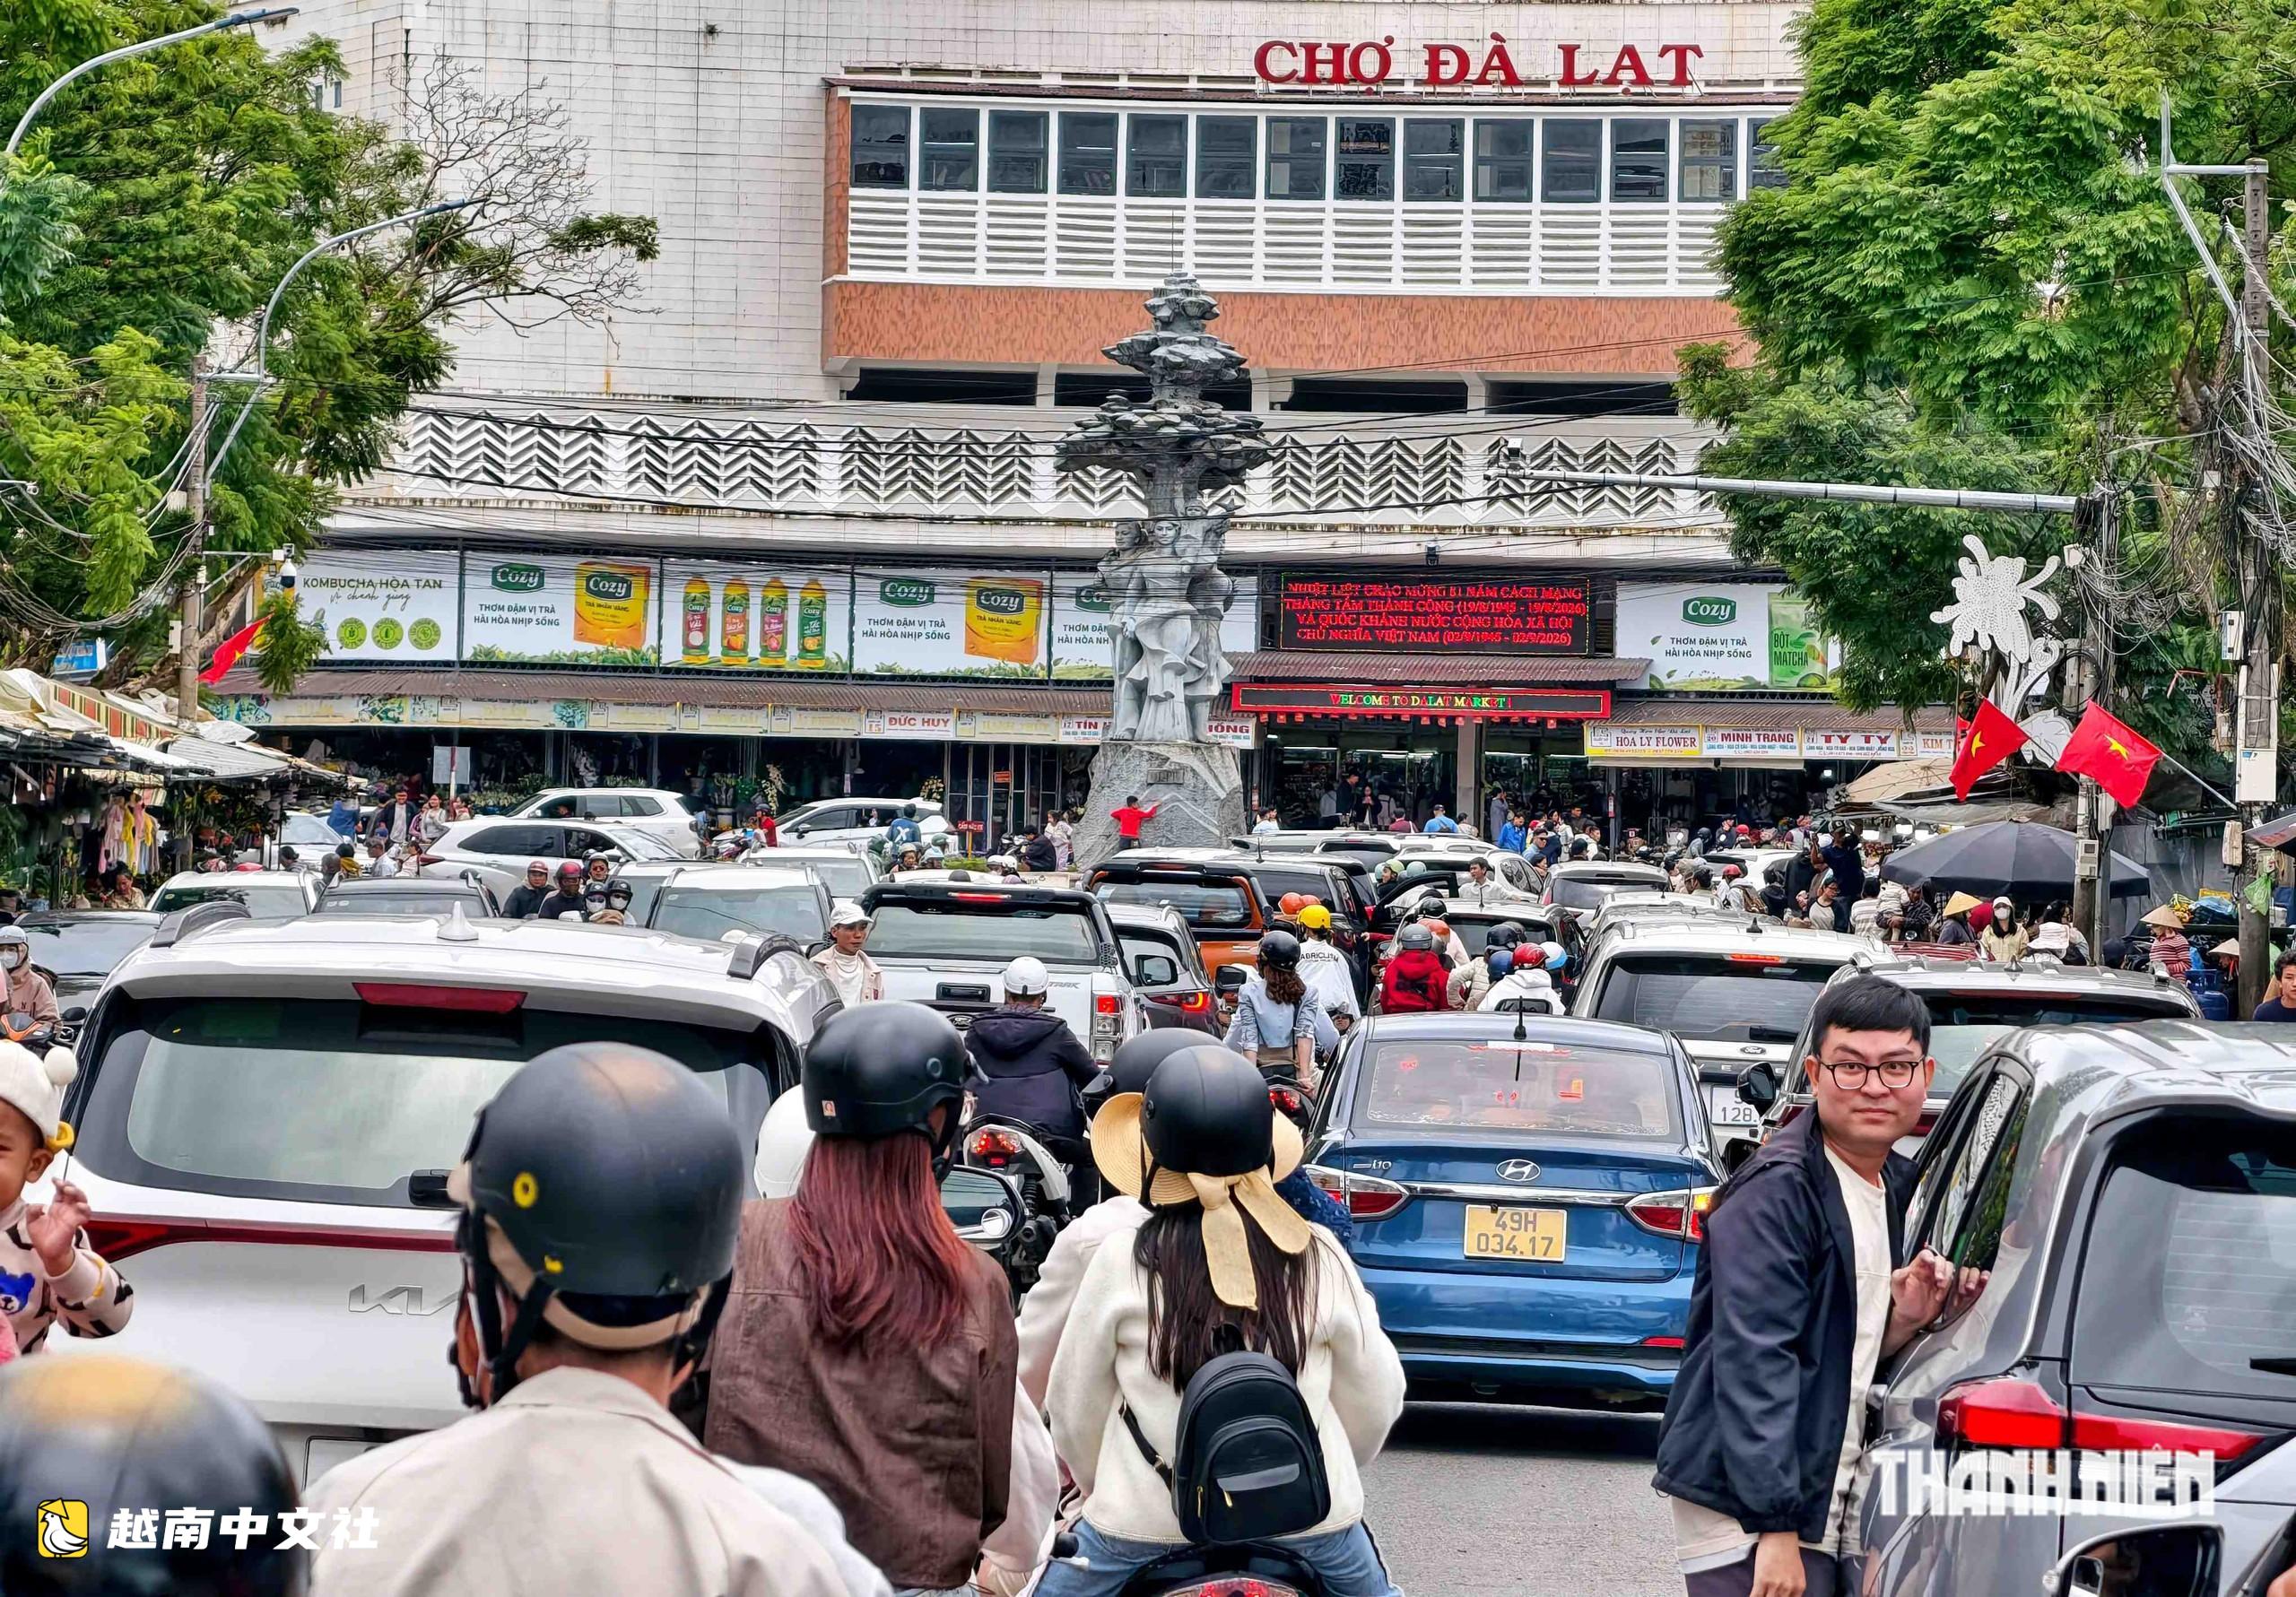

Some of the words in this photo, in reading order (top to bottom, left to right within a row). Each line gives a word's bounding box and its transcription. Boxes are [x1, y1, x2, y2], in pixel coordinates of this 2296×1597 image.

[1255, 35, 1395, 96] CHỢ
[1423, 31, 1523, 87] ĐÀ
[1557, 43, 1704, 96] LẠT
[303, 577, 378, 589] KOMBUCHA
[379, 577, 410, 589] HÒA
[414, 579, 442, 589] TAN
[496, 568, 539, 587] Cozy
[589, 577, 627, 597] Cozy
[884, 583, 929, 601] Cozy
[980, 592, 1020, 611] Cozy
[1080, 589, 1102, 603] Co
[479, 603, 505, 612] THƠM
[507, 603, 526, 615] ĐẬM
[528, 605, 536, 616] VỊ
[539, 603, 555, 613] TRÀ
[1687, 600, 1731, 621] Cozy
[474, 615, 489, 624] HÀI
[491, 615, 509, 625] HÒA
[511, 616, 533, 627] NHỊP
[535, 615, 560, 626] SỐNG
[867, 618, 894, 627] THƠM
[896, 617, 916, 629] ĐẬM
[918, 620, 926, 629] VỊ
[929, 618, 945, 629] TRÀ
[1063, 623, 1089, 632] THƠM
[862, 629, 877, 638] HÀI
[879, 629, 899, 639] HÒA
[900, 631, 923, 642] NHỊP
[925, 630, 951, 640] SỐNG
[1057, 634, 1073, 644] HÀI
[1075, 635, 1093, 645] HÒA
[1096, 637, 1109, 645] NH
[1407, 631, 1439, 643] NAM
[1774, 632, 1789, 650] BỘT
[1670, 637, 1696, 646] THƠM
[1699, 637, 1718, 647] ĐẬM
[1719, 638, 1728, 648] VỊ
[1731, 637, 1747, 647] TRÀ
[1665, 648, 1680, 657] HÀI
[1682, 647, 1701, 657] HÒA
[1703, 649, 1725, 660] NHỊP
[1726, 648, 1752, 658] SỐNG
[1774, 651, 1809, 667] MATCHA
[1330, 694, 1390, 707] WELCOME
[1392, 695, 1409, 706] TO
[1411, 695, 1452, 707] DALAT
[1454, 696, 1506, 707] MARKET
[889, 715, 917, 726] ĐỨC
[922, 718, 950, 727] HUY
[1075, 720, 1098, 729] TÍN
[1616, 736, 1636, 747] HOA
[1639, 736, 1652, 747] LY
[1656, 736, 1698, 748] FLOWER
[1721, 733, 1752, 742] MINH
[1757, 733, 1794, 742] TRANG
[1922, 738, 1944, 749] KIM
[1946, 739, 1953, 749] T
[1721, 1107, 1757, 1122] 128.
[1372, 1159, 1392, 1170] i10
[1494, 1211, 1537, 1233] 49H
[1476, 1232, 1554, 1257] 034.17
